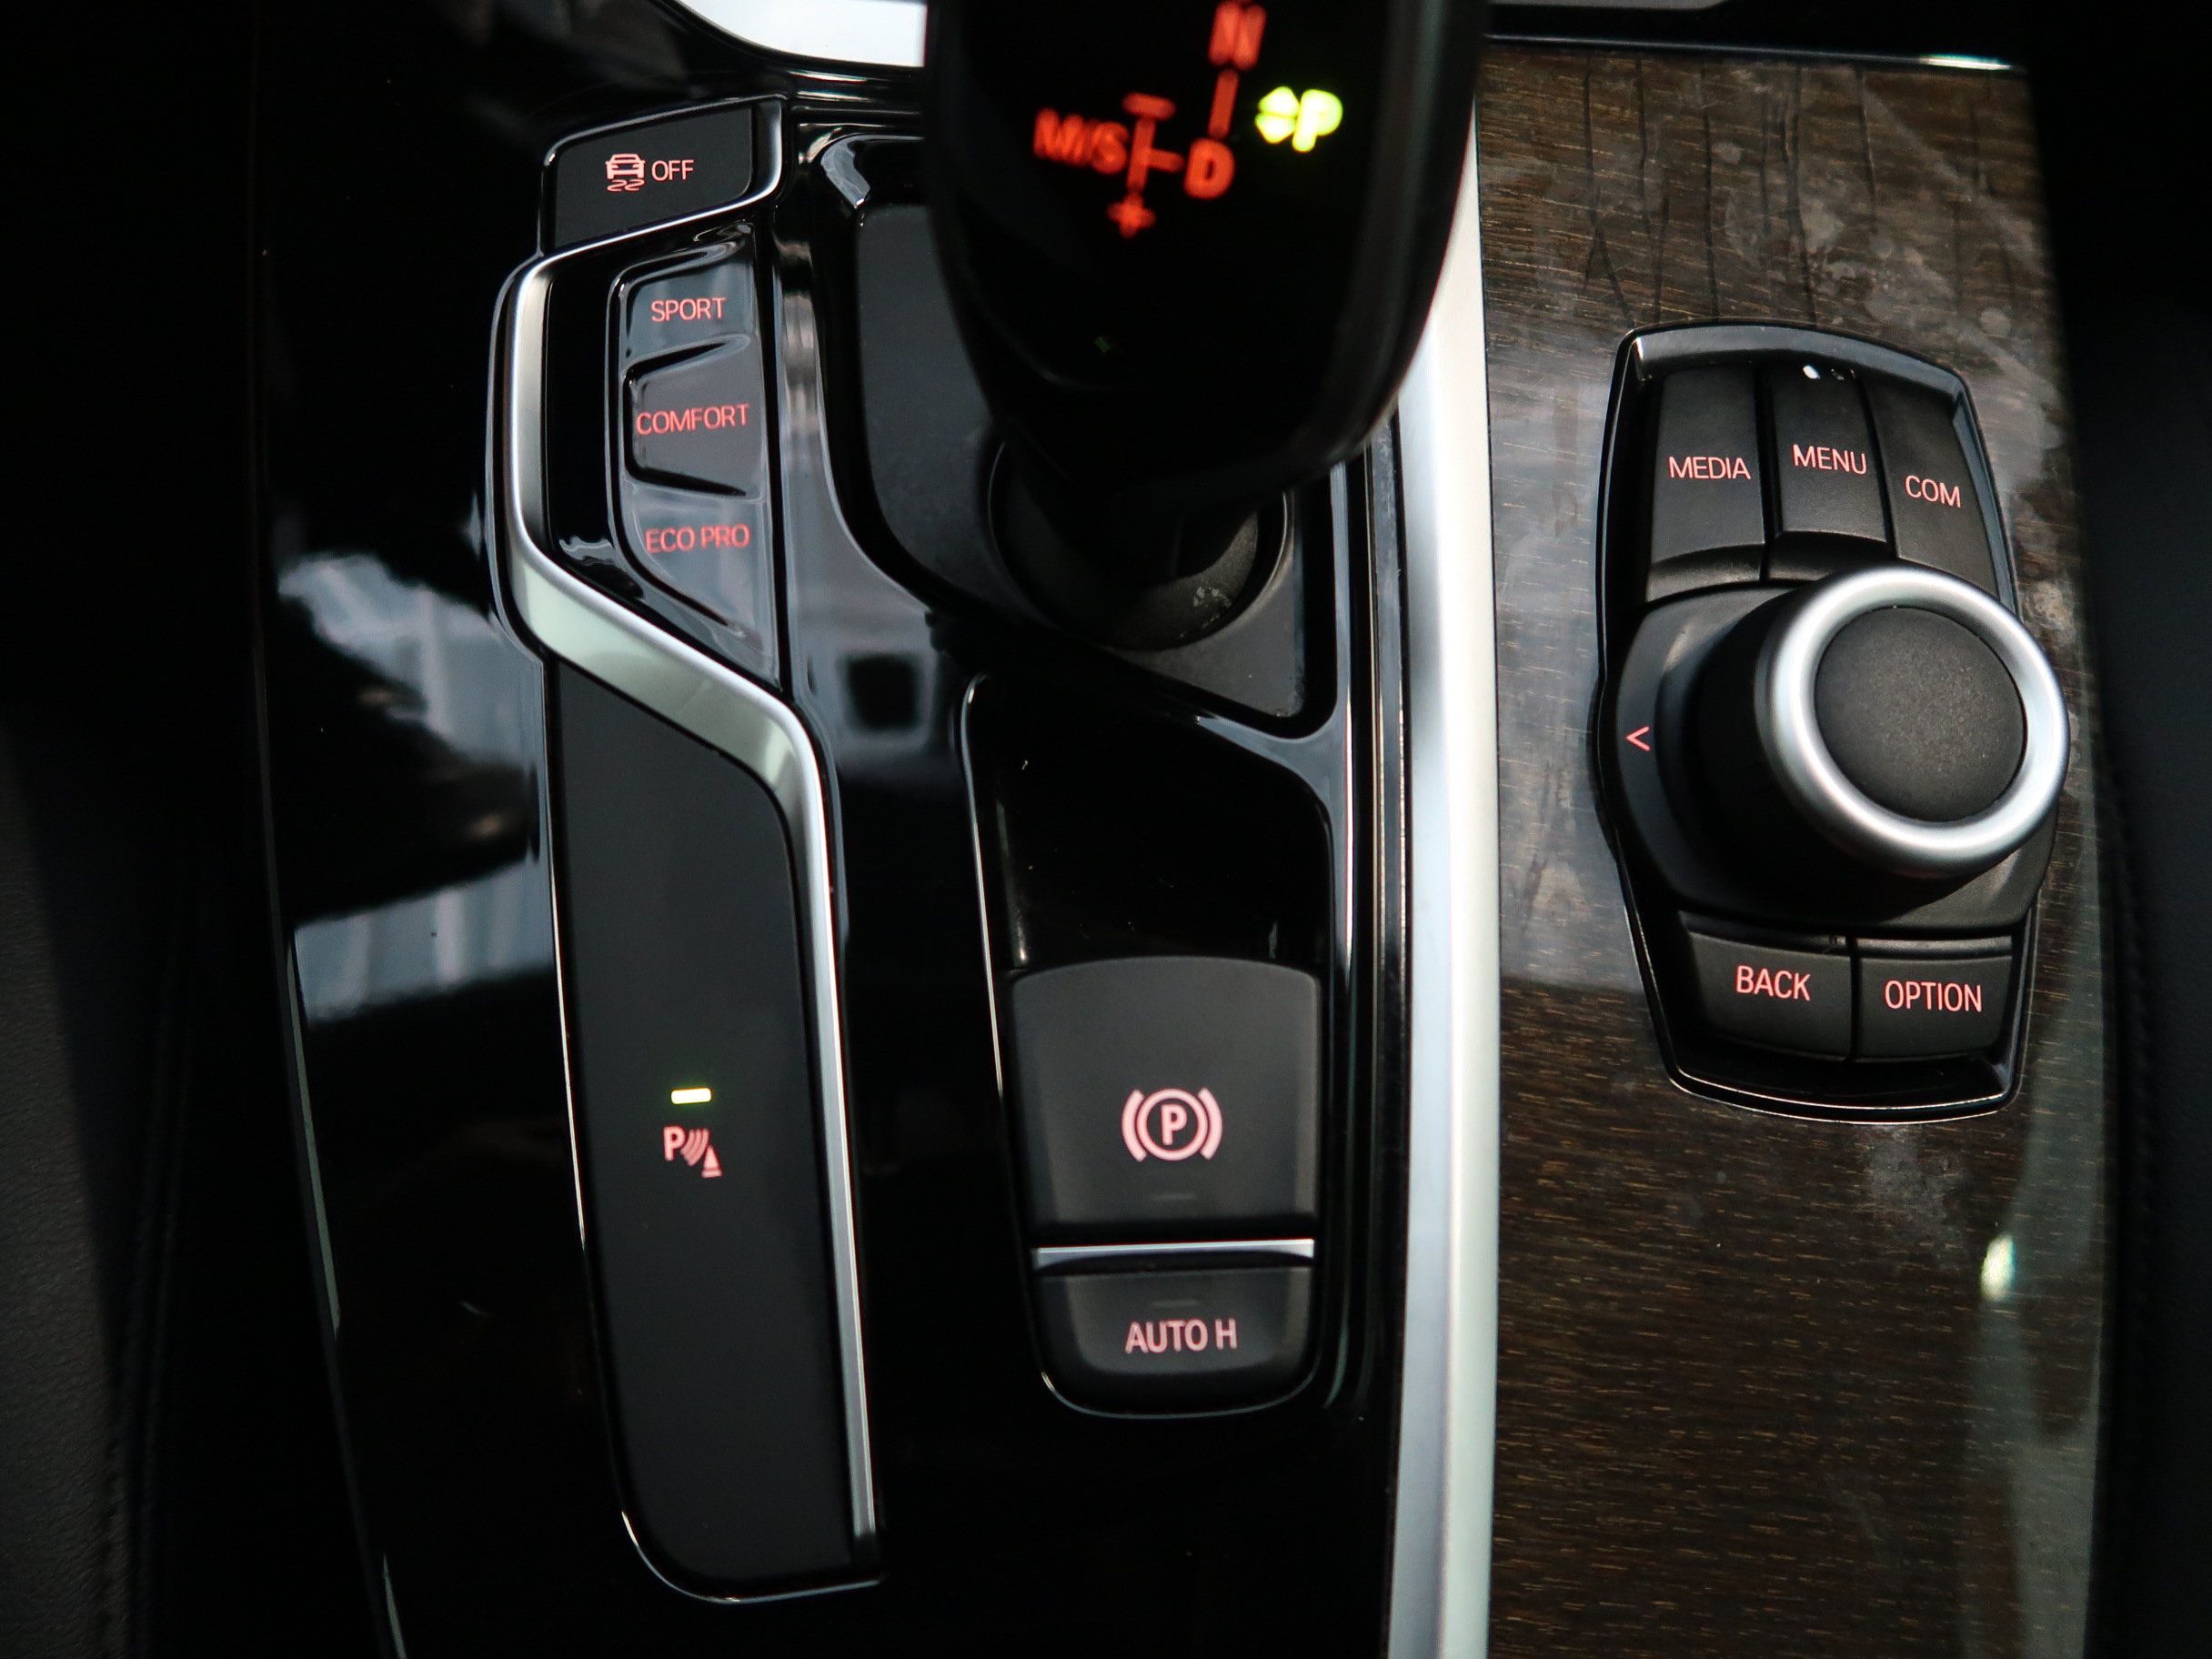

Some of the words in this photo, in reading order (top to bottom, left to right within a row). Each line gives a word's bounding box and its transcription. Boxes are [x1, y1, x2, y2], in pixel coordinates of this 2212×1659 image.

[1292, 88, 1343, 153] P
[650, 159, 695, 182] OFF
[1183, 137, 1236, 200] D
[650, 297, 726, 323] SPORT
[636, 403, 750, 436] COMFORT
[1668, 456, 1751, 480] MEDIA
[1792, 444, 1867, 475] MENU
[1905, 476, 1962, 508] COM
[645, 528, 696, 554] ECO
[699, 524, 751, 549] PRO
[1734, 964, 1811, 1001] BACK
[1884, 980, 1983, 1012] OPTION
[1159, 1102, 1188, 1146] P
[662, 1124, 686, 1161] P
[1124, 1319, 1209, 1354] AUTO
[1214, 1318, 1238, 1350] H
